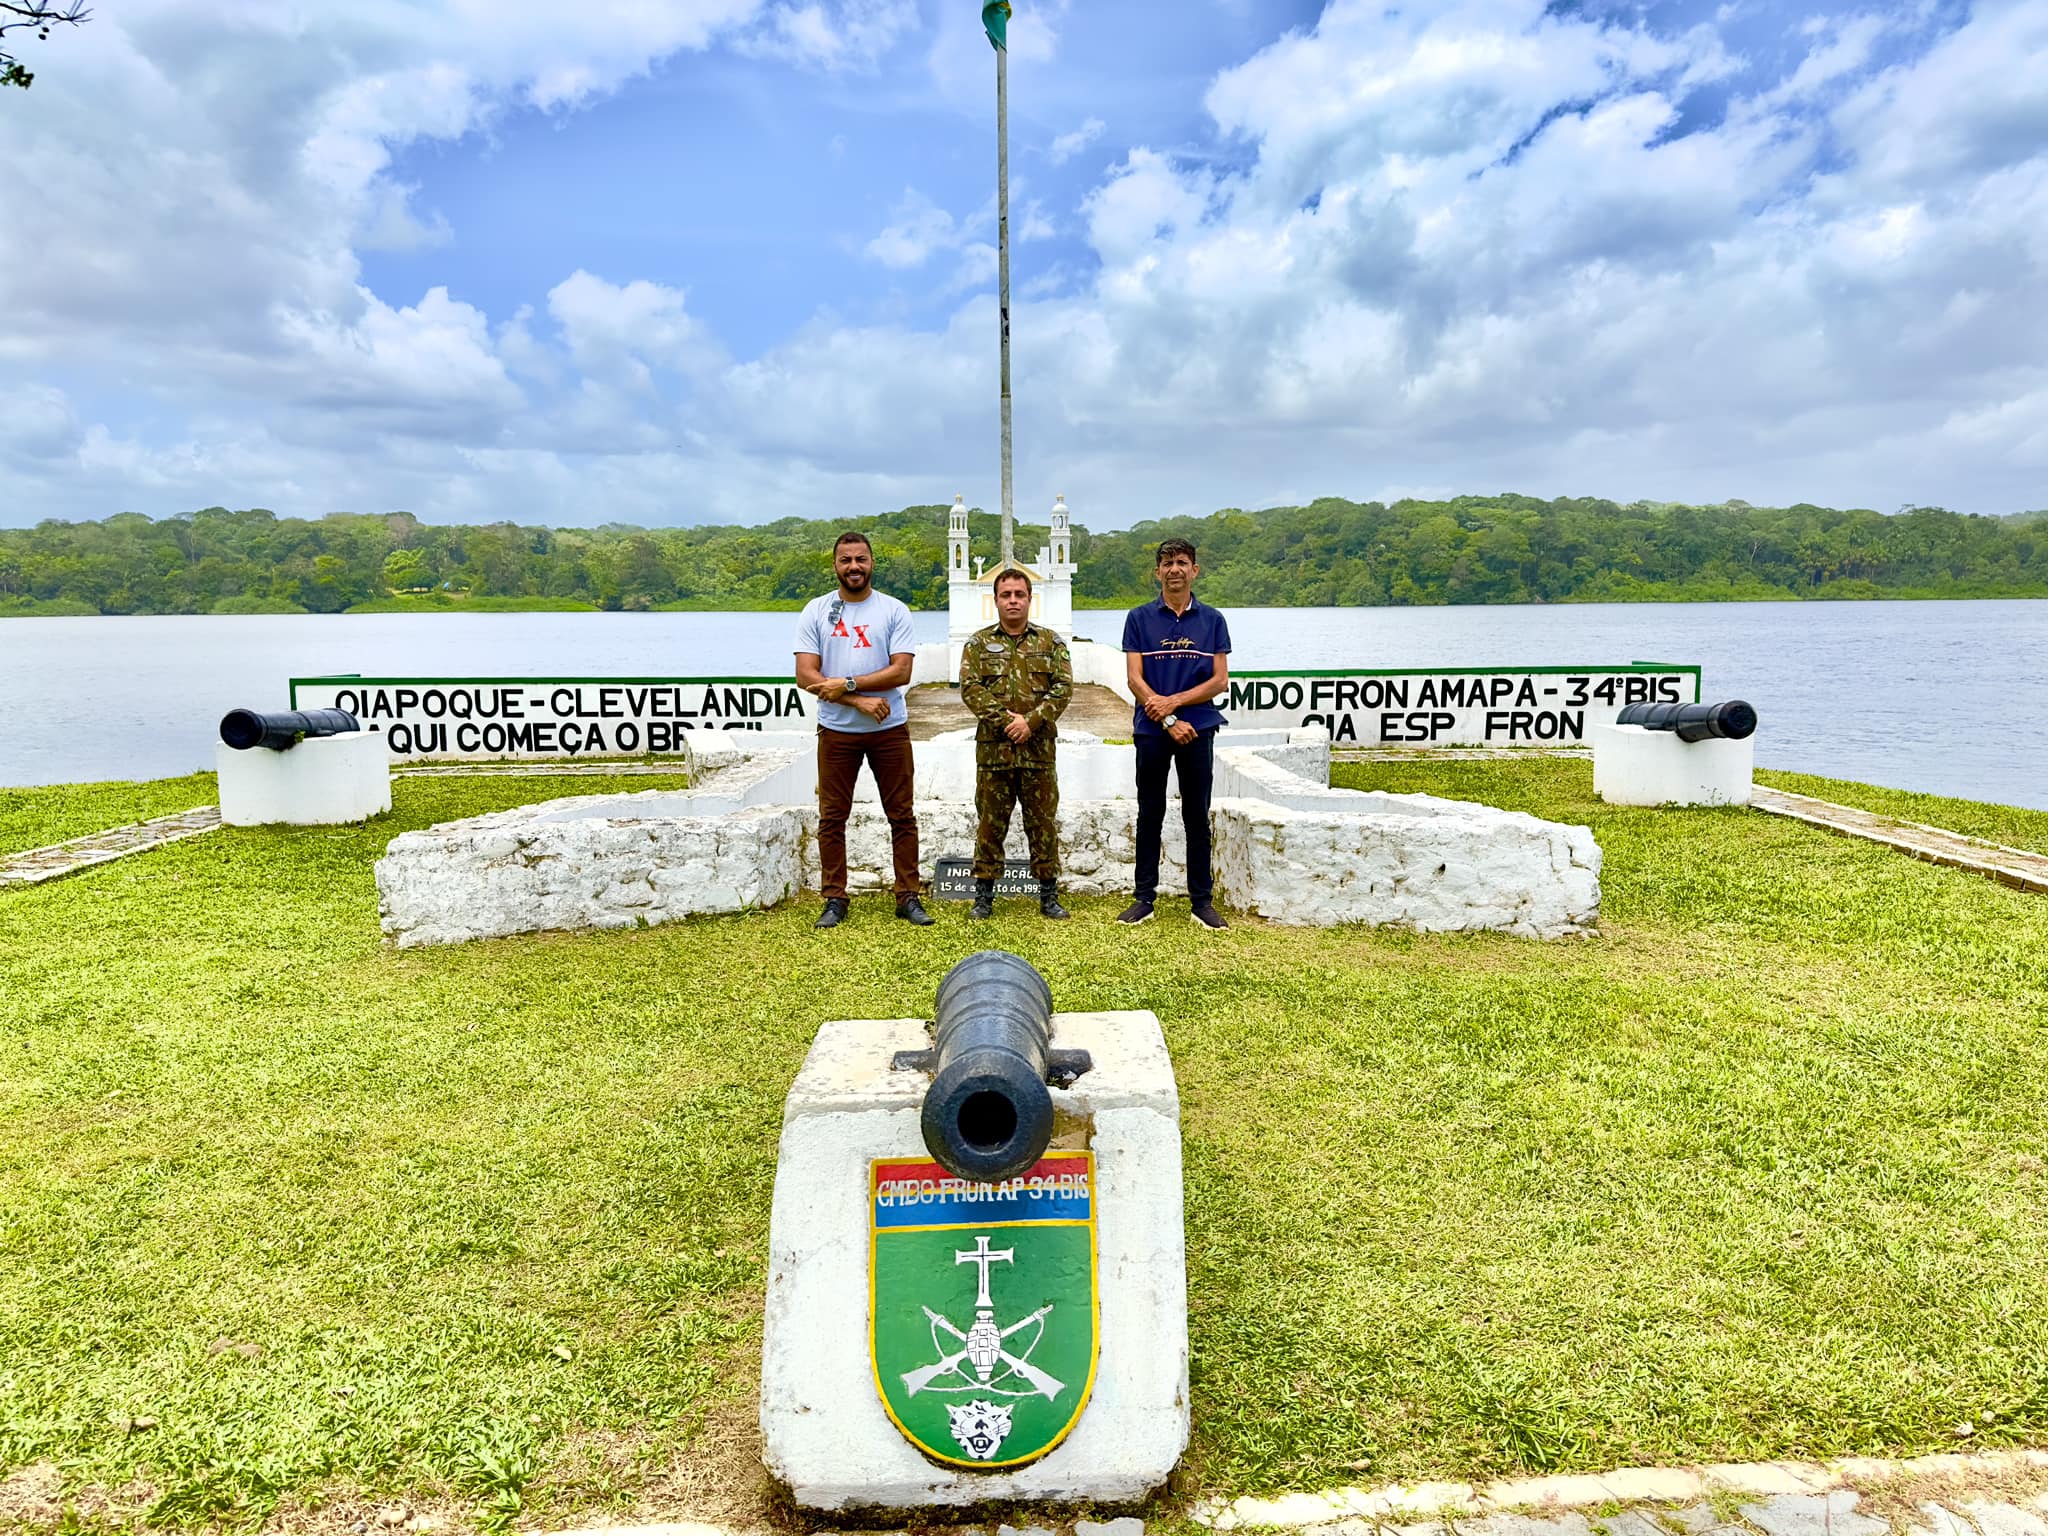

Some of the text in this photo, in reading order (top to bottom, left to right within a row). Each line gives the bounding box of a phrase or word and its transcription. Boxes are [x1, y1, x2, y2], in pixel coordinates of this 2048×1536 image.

[335, 689, 524, 719] OIAPOQUE
[1311, 680, 1408, 710] FRON
[1417, 674, 1537, 708] AMAPÁ
[369, 722, 447, 754] QUI
[457, 722, 607, 755] COMEÇA
[615, 722, 639, 751] O
[1381, 712, 1455, 741] ESP
[1485, 711, 1584, 740] FRON
[940, 881, 952, 892] 15
[1010, 883, 1022, 893] de
[878, 1179, 935, 1207] CMDO
[996, 1176, 1024, 1201] AP
